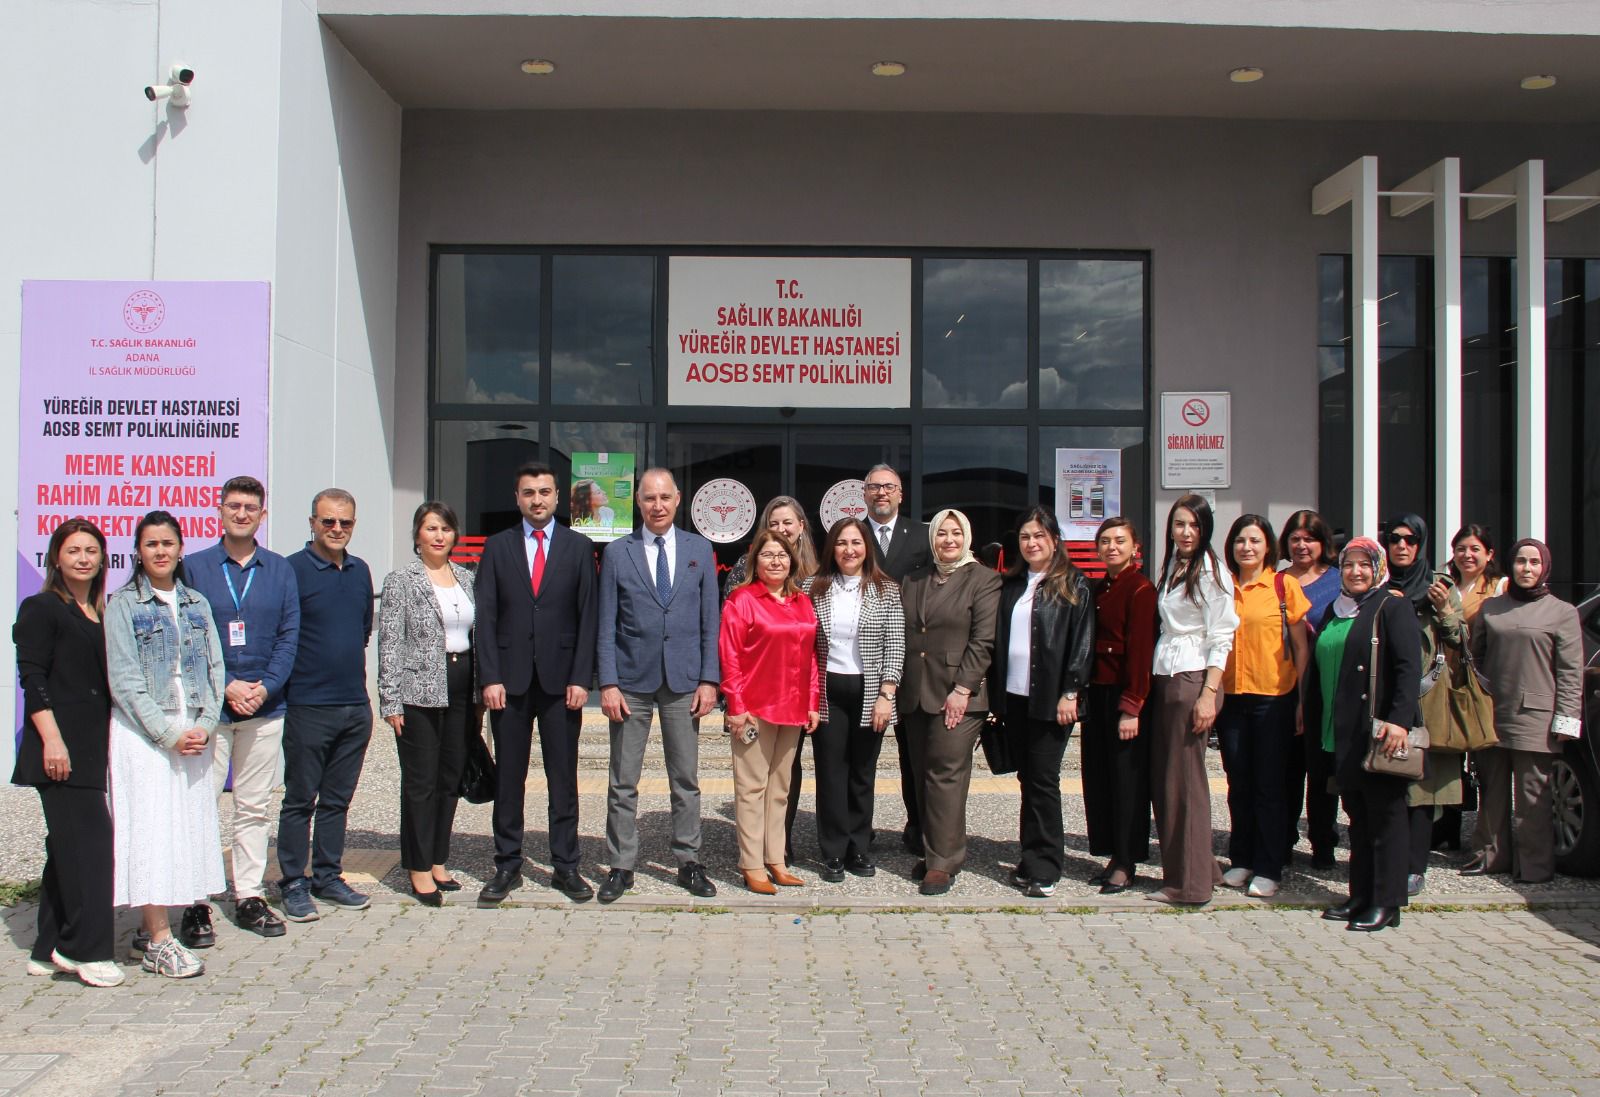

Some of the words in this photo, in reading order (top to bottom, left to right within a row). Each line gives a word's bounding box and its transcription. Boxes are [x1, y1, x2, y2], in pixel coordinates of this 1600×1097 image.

[776, 280, 803, 299] T.C.
[717, 303, 773, 327] SAĞLIK
[777, 304, 862, 328] BAKANLIĞI
[91, 339, 108, 347] T.C.
[109, 337, 143, 347] SAĞLIK
[145, 337, 196, 348] BAKANLIĞI
[679, 329, 746, 354] YÜREĞİR
[751, 335, 809, 355] DEVLET
[814, 332, 900, 356] HASTANESİ
[125, 353, 160, 362] ADANA
[99, 366, 132, 376] SAĞLIK
[134, 366, 196, 376] MÜDÜRLÜĞÜ
[686, 362, 748, 383] AOSB
[752, 363, 795, 384] SEMT
[799, 360, 892, 385] POLİKLİNİĞİ
[43, 396, 103, 416] YÜREĞİR
[107, 400, 158, 416] DEVLET
[161, 397, 240, 417] HASTANESİ
[43, 421, 80, 437] AOSB
[84, 422, 123, 438] SEMT
[127, 418, 240, 439] POLİKLİNİĞİNDE
[1168, 433, 1194, 449] SİGARA
[1196, 433, 1224, 450] İÇİLMEZ
[65, 454, 125, 476] MEME
[131, 451, 216, 478] KANSERİ
[37, 480, 101, 507] RAHİM
[107, 481, 151, 507] AĞZI
[158, 485, 223, 508] KANSE
